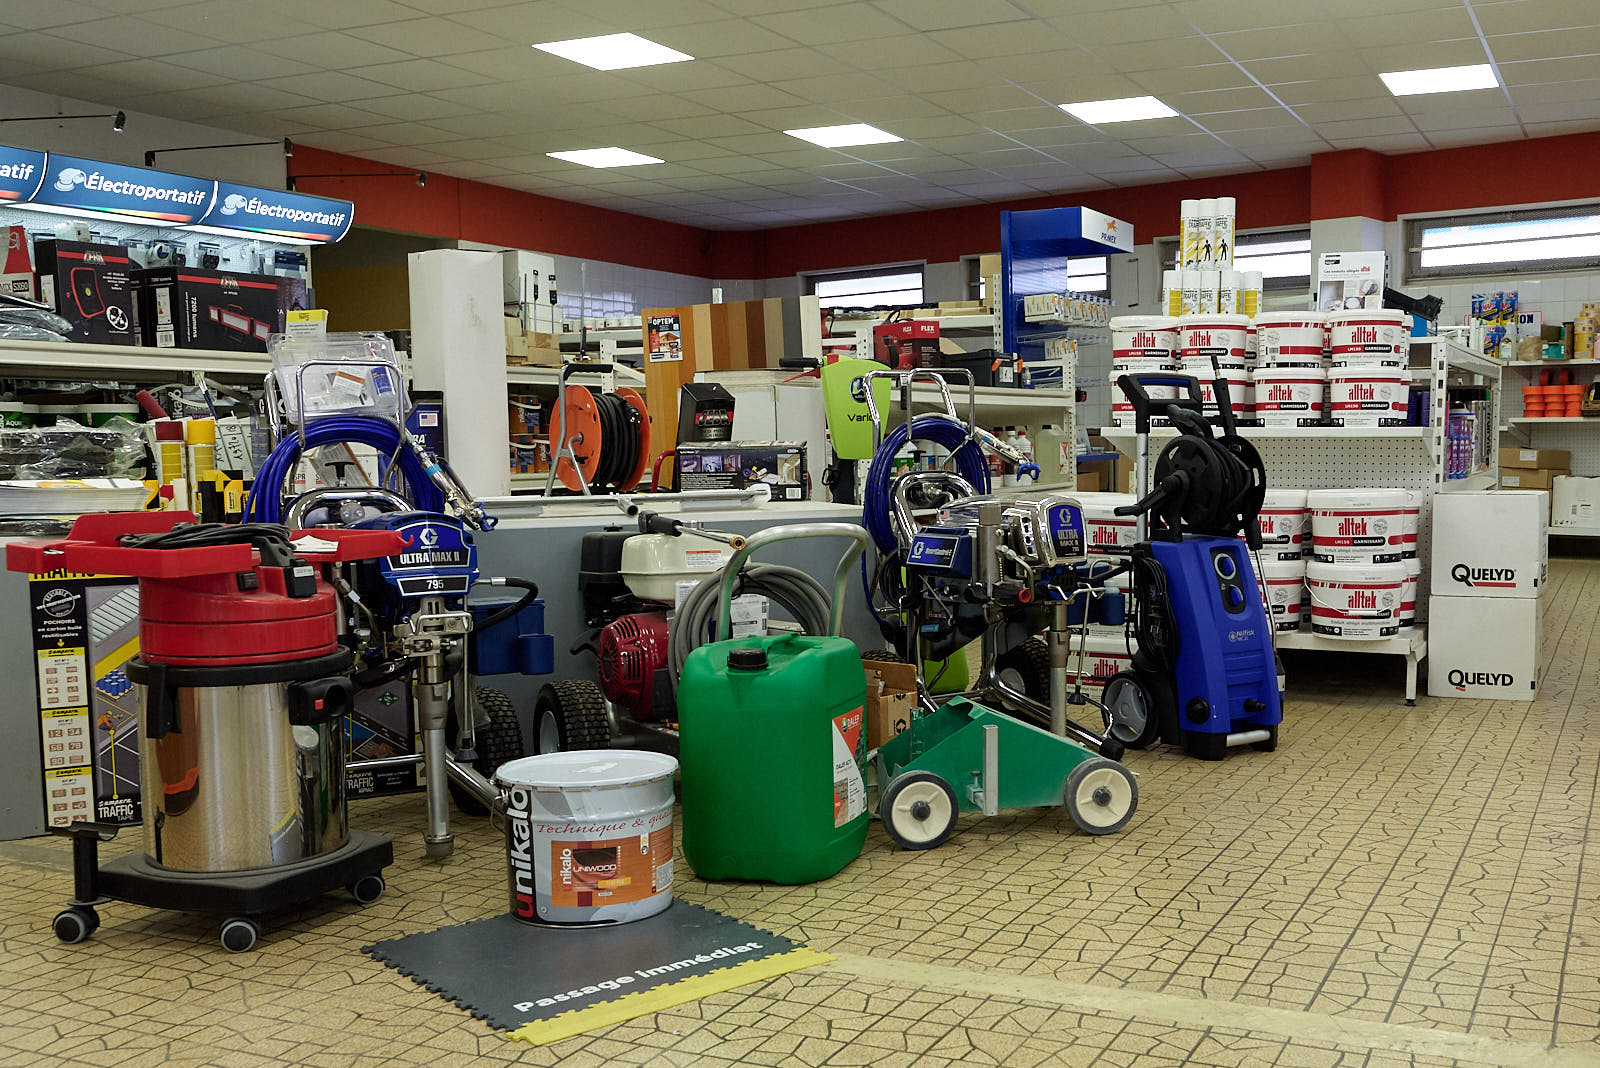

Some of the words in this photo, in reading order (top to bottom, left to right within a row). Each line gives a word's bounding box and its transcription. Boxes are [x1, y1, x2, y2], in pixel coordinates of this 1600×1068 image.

[87, 172, 206, 206] Électroportatif
[248, 196, 345, 227] Électroportatif
[1132, 332, 1156, 348] alltek
[1189, 331, 1211, 347] alltek
[1351, 326, 1378, 343] alltek
[1268, 384, 1293, 401] alltek
[1348, 384, 1374, 401] alltek
[1092, 526, 1118, 545] alltek
[1338, 517, 1368, 536] alltek
[400, 552, 430, 565] ULTRA
[431, 551, 452, 563] MAX
[426, 579, 444, 590] 795
[1451, 563, 1516, 588] QUELYD
[1348, 590, 1377, 609] alltek
[1094, 658, 1120, 677] alltek
[1447, 669, 1514, 689] QUELYD
[346, 777, 374, 790] TRAFFIC
[98, 804, 134, 819] TRAFFIC
[118, 814, 134, 822] TAPE
[536, 822, 627, 838] Technique
[631, 817, 644, 828] &
[507, 784, 536, 919] unikalo
[560, 848, 572, 892] unikalo
[572, 864, 617, 873] UNIWOOD
[512, 976, 635, 1013] Passage
[634, 942, 764, 978] immédiat
